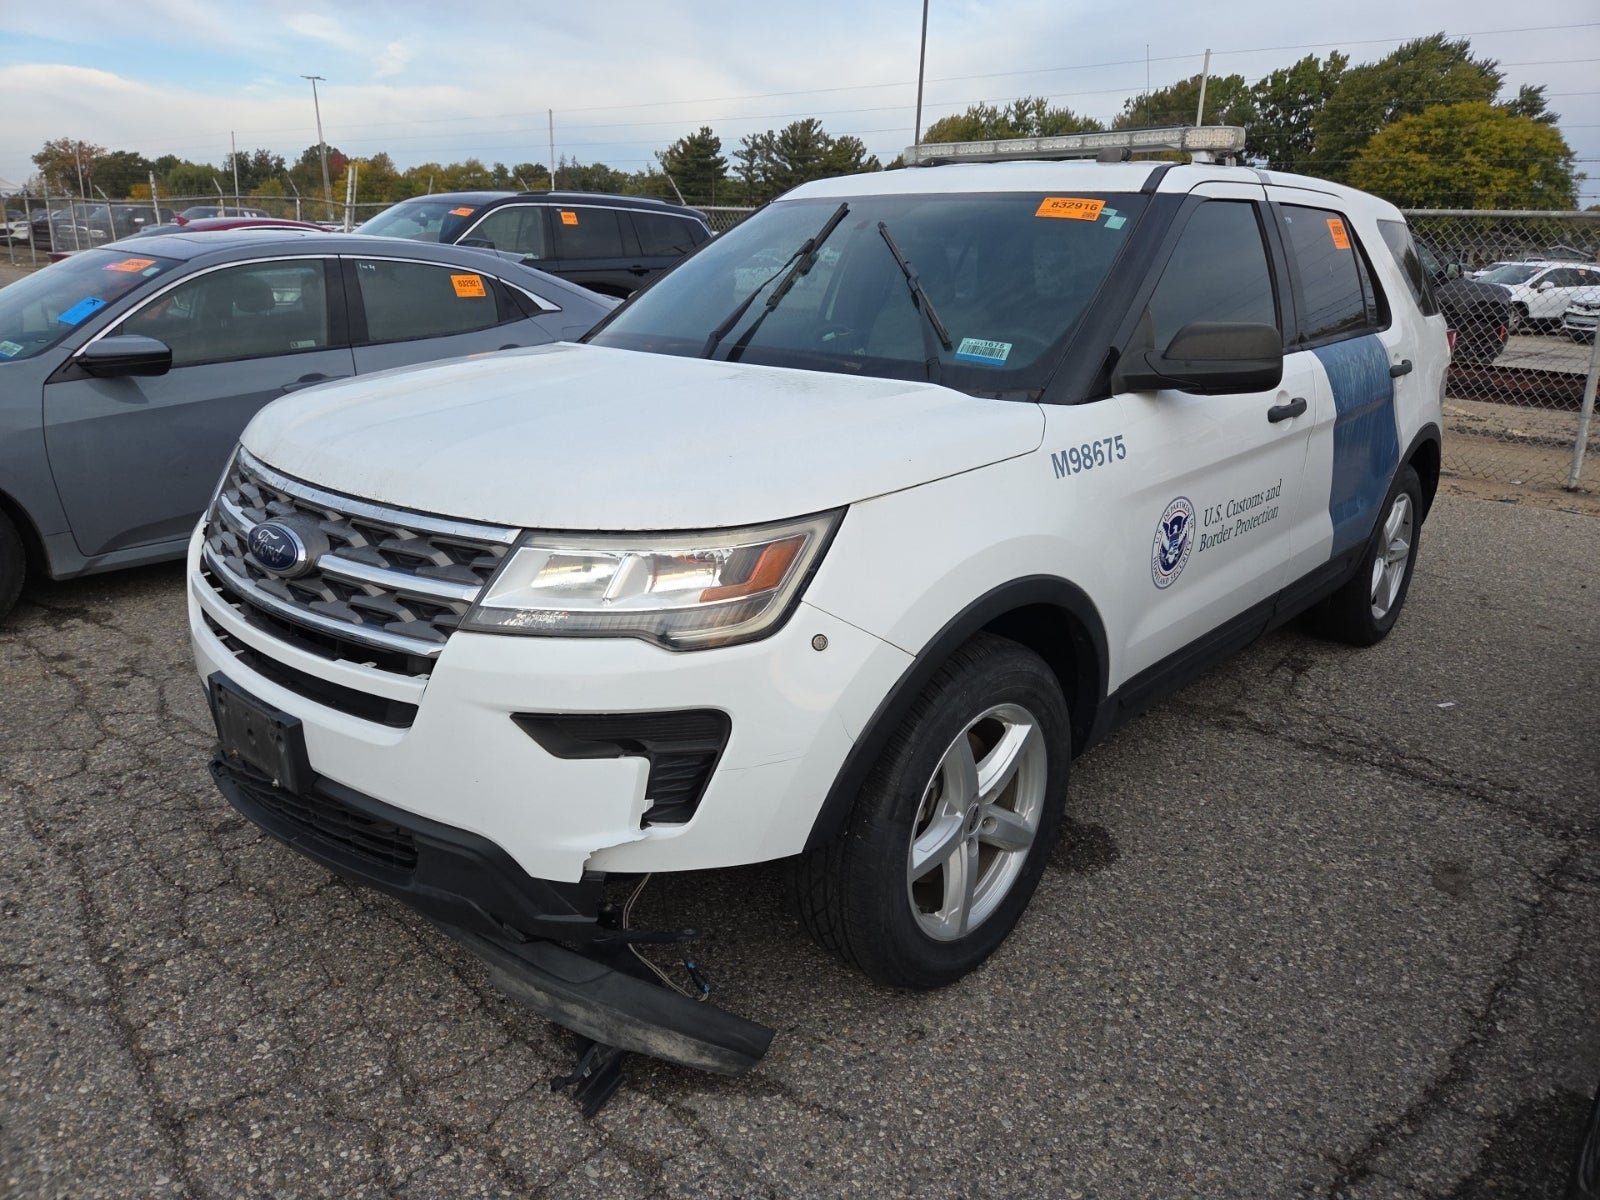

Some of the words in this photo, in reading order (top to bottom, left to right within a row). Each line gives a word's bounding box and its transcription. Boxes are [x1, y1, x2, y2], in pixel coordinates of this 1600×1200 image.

[1051, 201, 1099, 211] 832916
[457, 279, 481, 288] 832921
[1050, 434, 1127, 480] M98675
[1204, 504, 1223, 528] U.S.
[1226, 491, 1265, 519] Customs
[1265, 478, 1283, 502] and
[253, 529, 286, 562] Ford
[1199, 525, 1234, 553] Border
[1234, 505, 1279, 537] Protection
